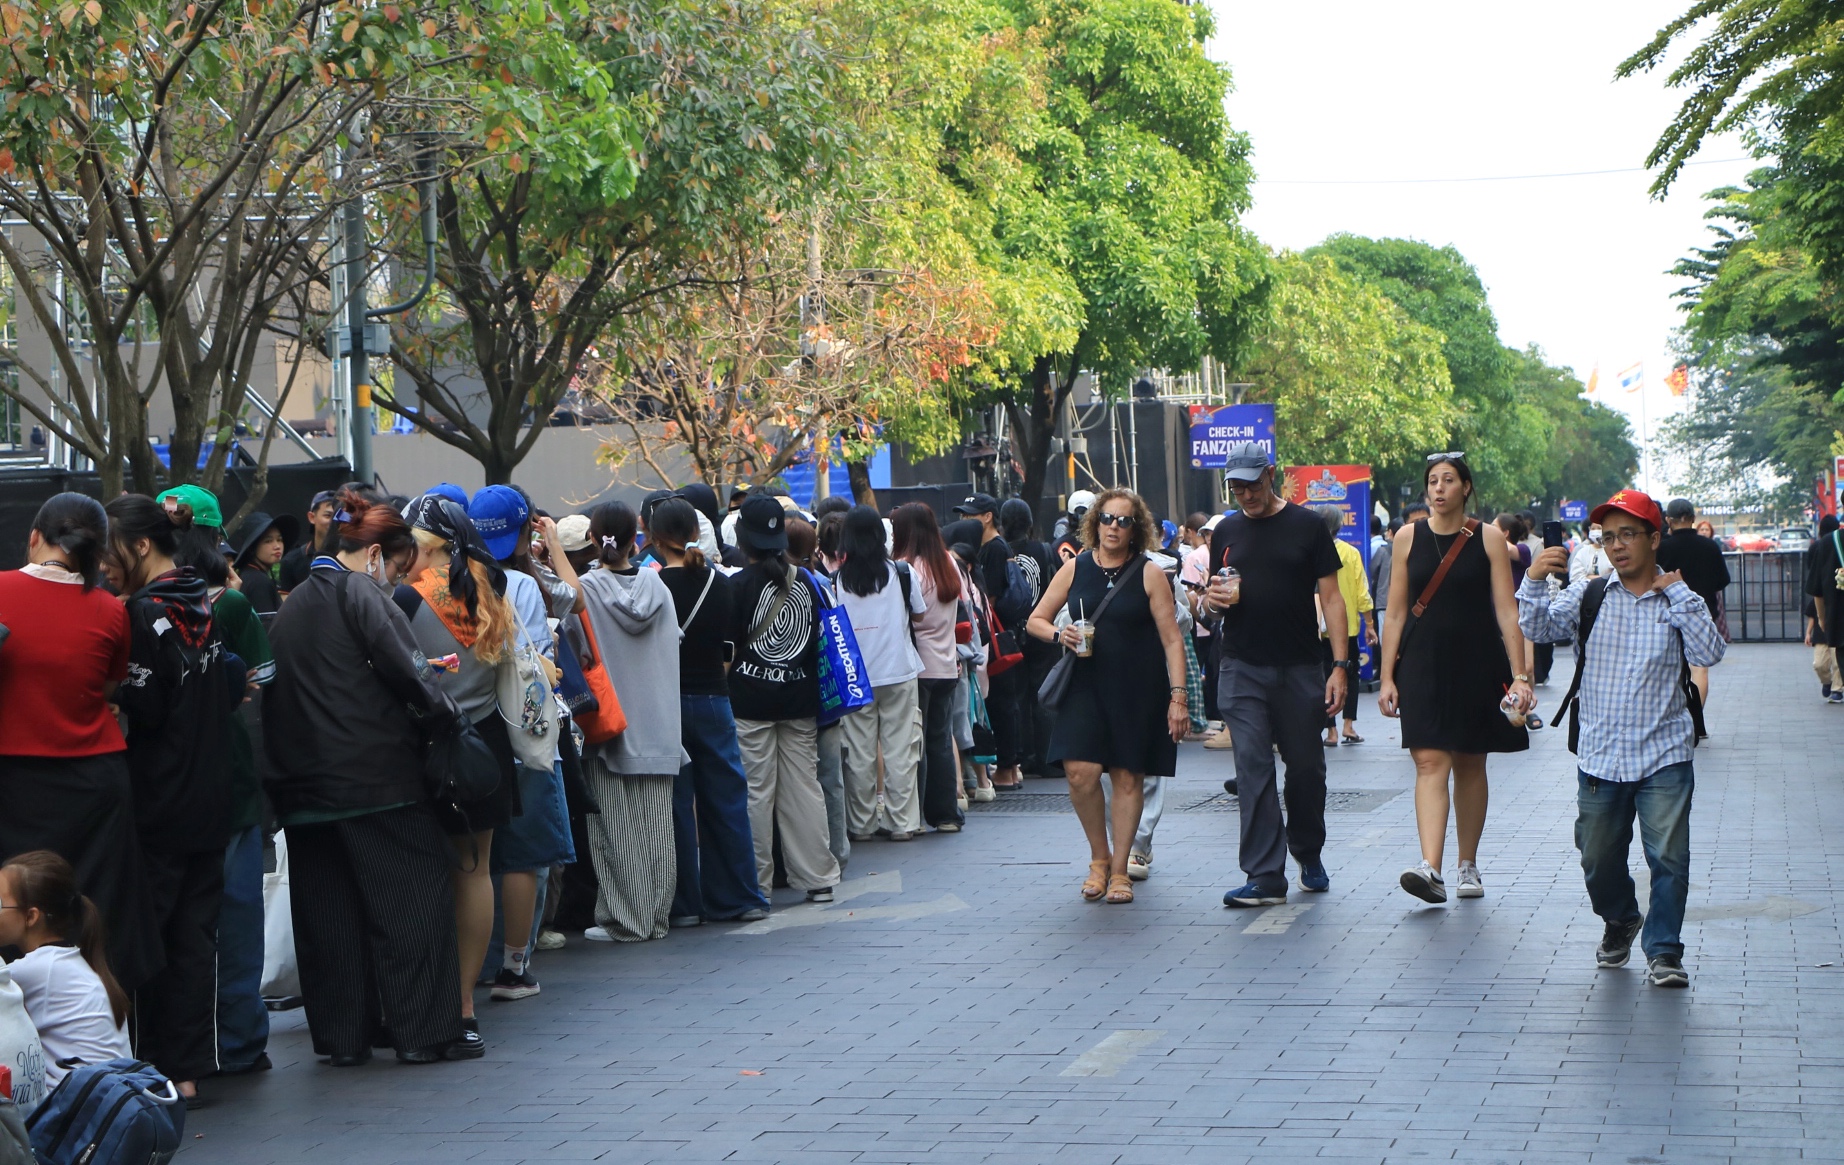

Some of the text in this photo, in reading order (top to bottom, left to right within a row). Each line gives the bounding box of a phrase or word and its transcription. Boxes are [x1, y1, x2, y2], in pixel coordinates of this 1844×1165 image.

[1209, 426, 1254, 438] CHECK-IN
[1193, 440, 1254, 455] FANZO
[829, 615, 858, 683] DECATHLON
